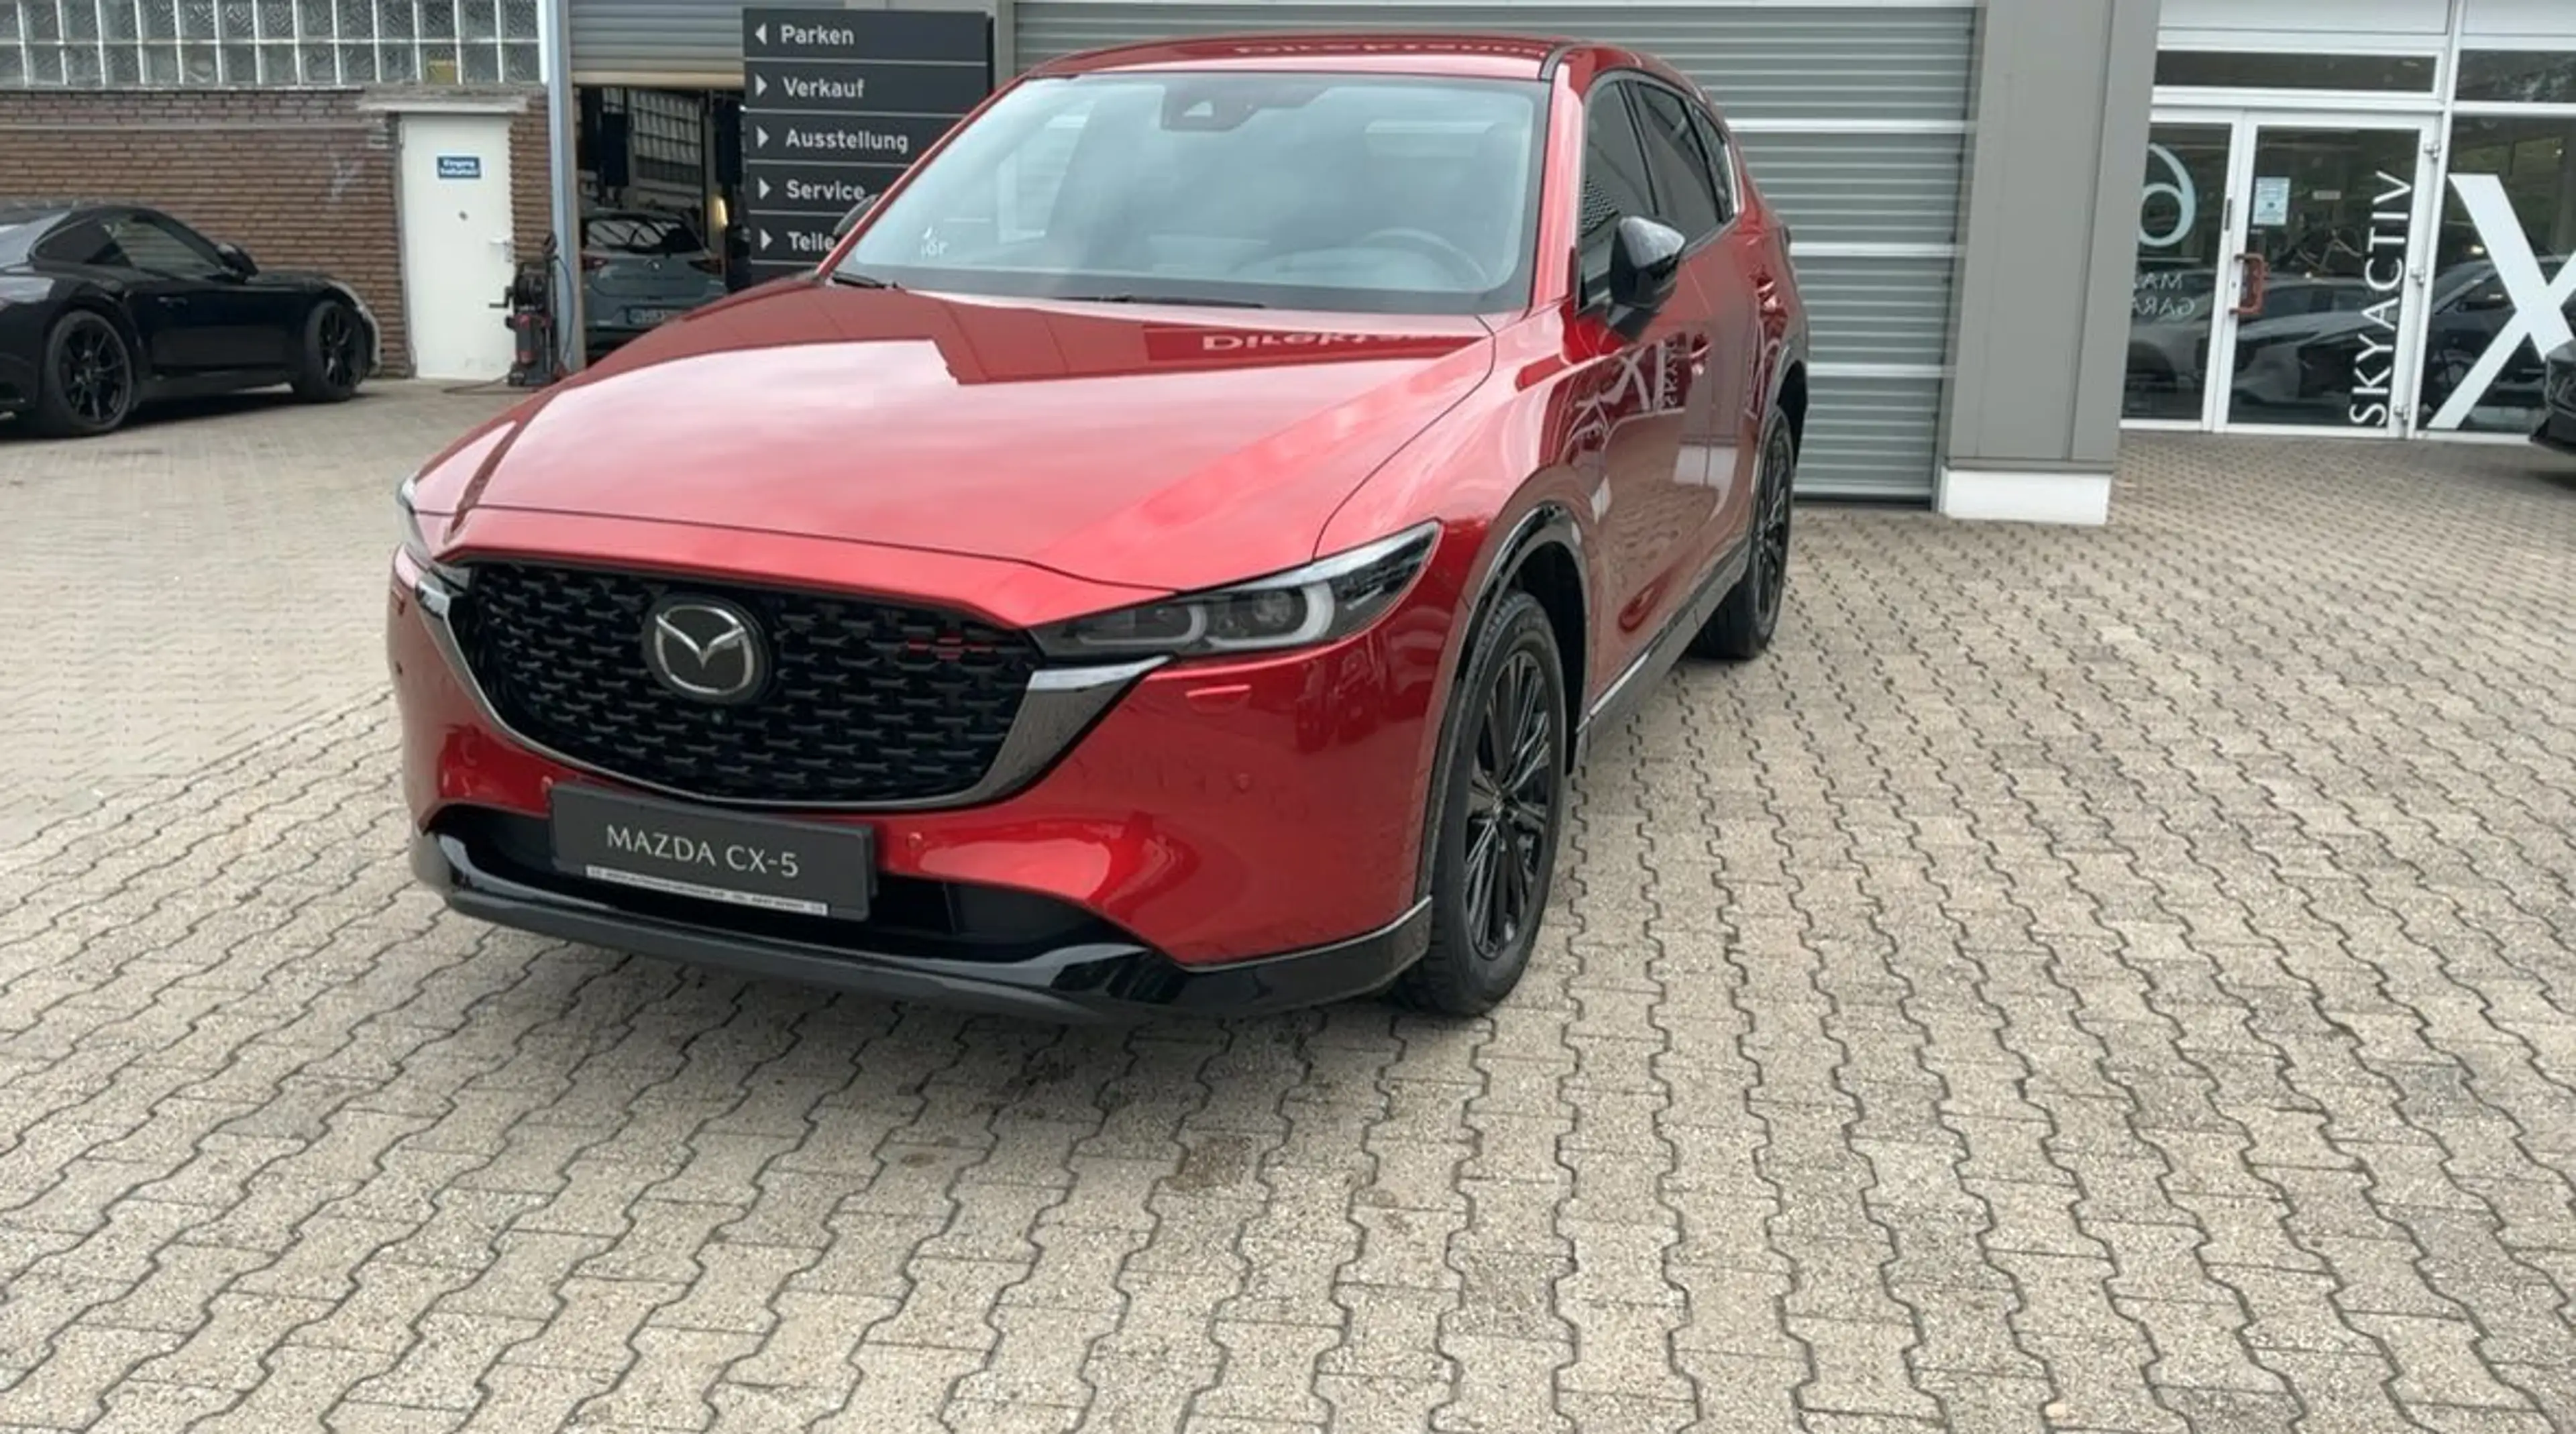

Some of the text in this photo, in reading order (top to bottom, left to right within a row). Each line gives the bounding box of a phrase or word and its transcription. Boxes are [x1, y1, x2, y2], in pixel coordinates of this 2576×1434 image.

[780, 24, 855, 45] Parken
[783, 76, 865, 97] Verkauf
[786, 128, 909, 154] Ausstellung
[786, 179, 866, 200] Service
[787, 231, 837, 252] Teile
[2349, 170, 2412, 427] SKYACTIV
[606, 824, 800, 878] MAZDA CX-5
